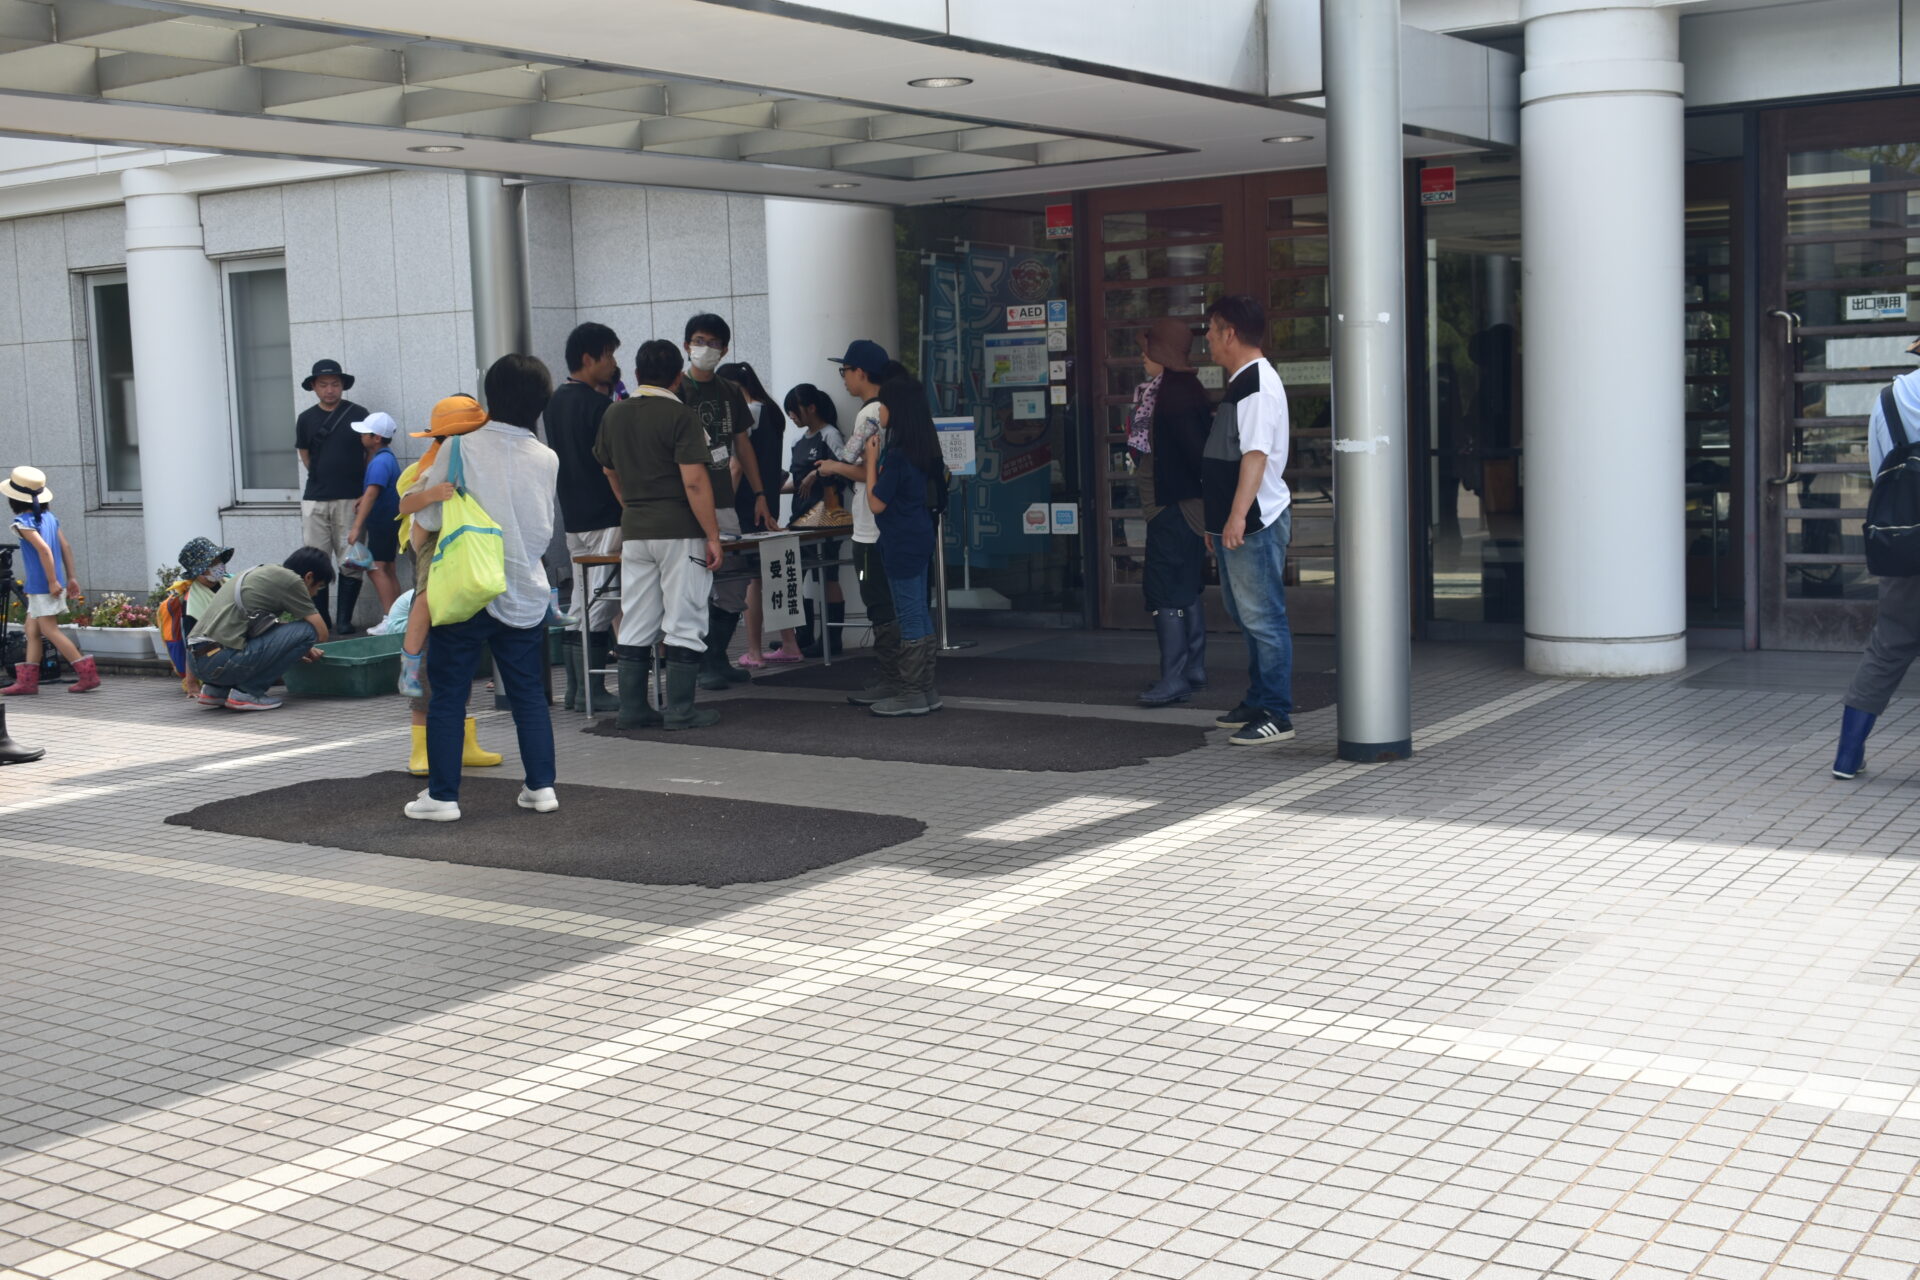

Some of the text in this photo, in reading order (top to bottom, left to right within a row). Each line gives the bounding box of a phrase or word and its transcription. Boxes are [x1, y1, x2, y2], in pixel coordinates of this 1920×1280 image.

[1423, 191, 1453, 202] SECOM
[1047, 227, 1073, 236] SECOM
[1851, 296, 1901, 310] 出口専用
[1019, 306, 1043, 318] AED
[769, 559, 783, 610] 受付
